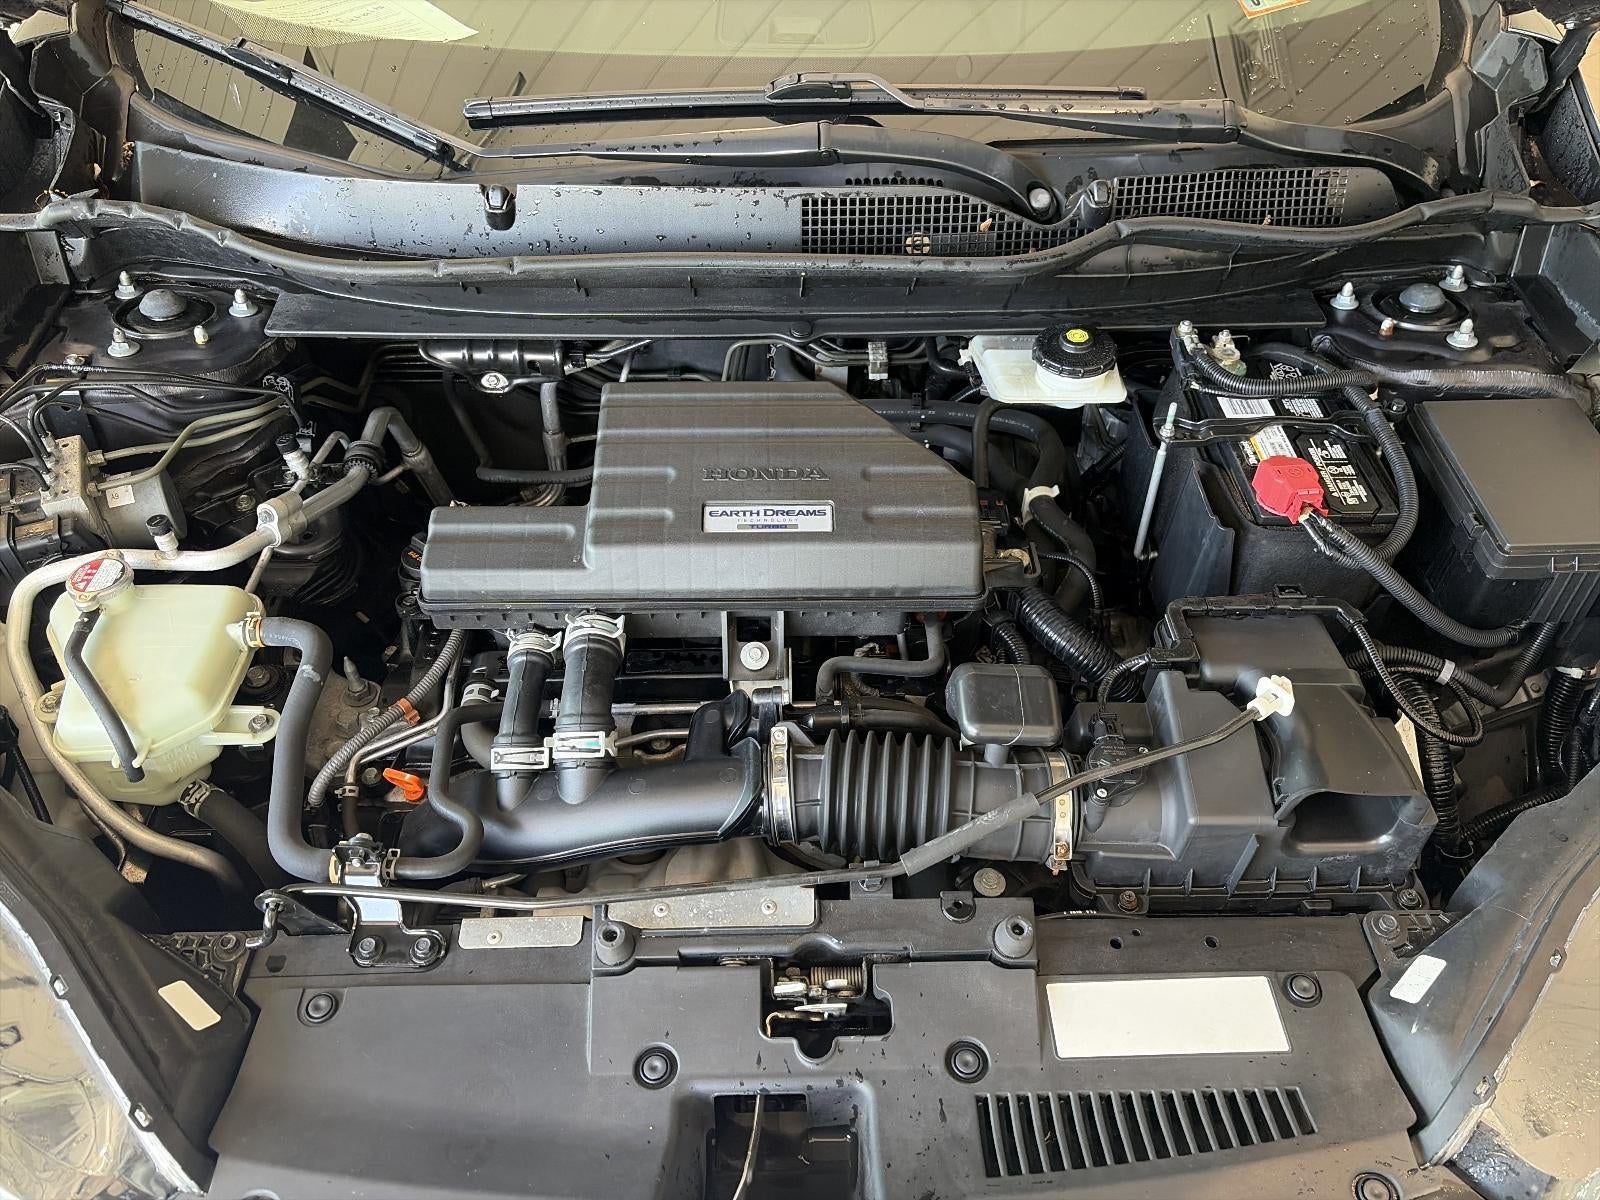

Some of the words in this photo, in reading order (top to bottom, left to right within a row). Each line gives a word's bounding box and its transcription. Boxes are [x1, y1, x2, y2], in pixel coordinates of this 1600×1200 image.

[702, 466, 830, 481] HONDA
[708, 509, 760, 518] EARTH
[763, 508, 827, 517] DREAMS
